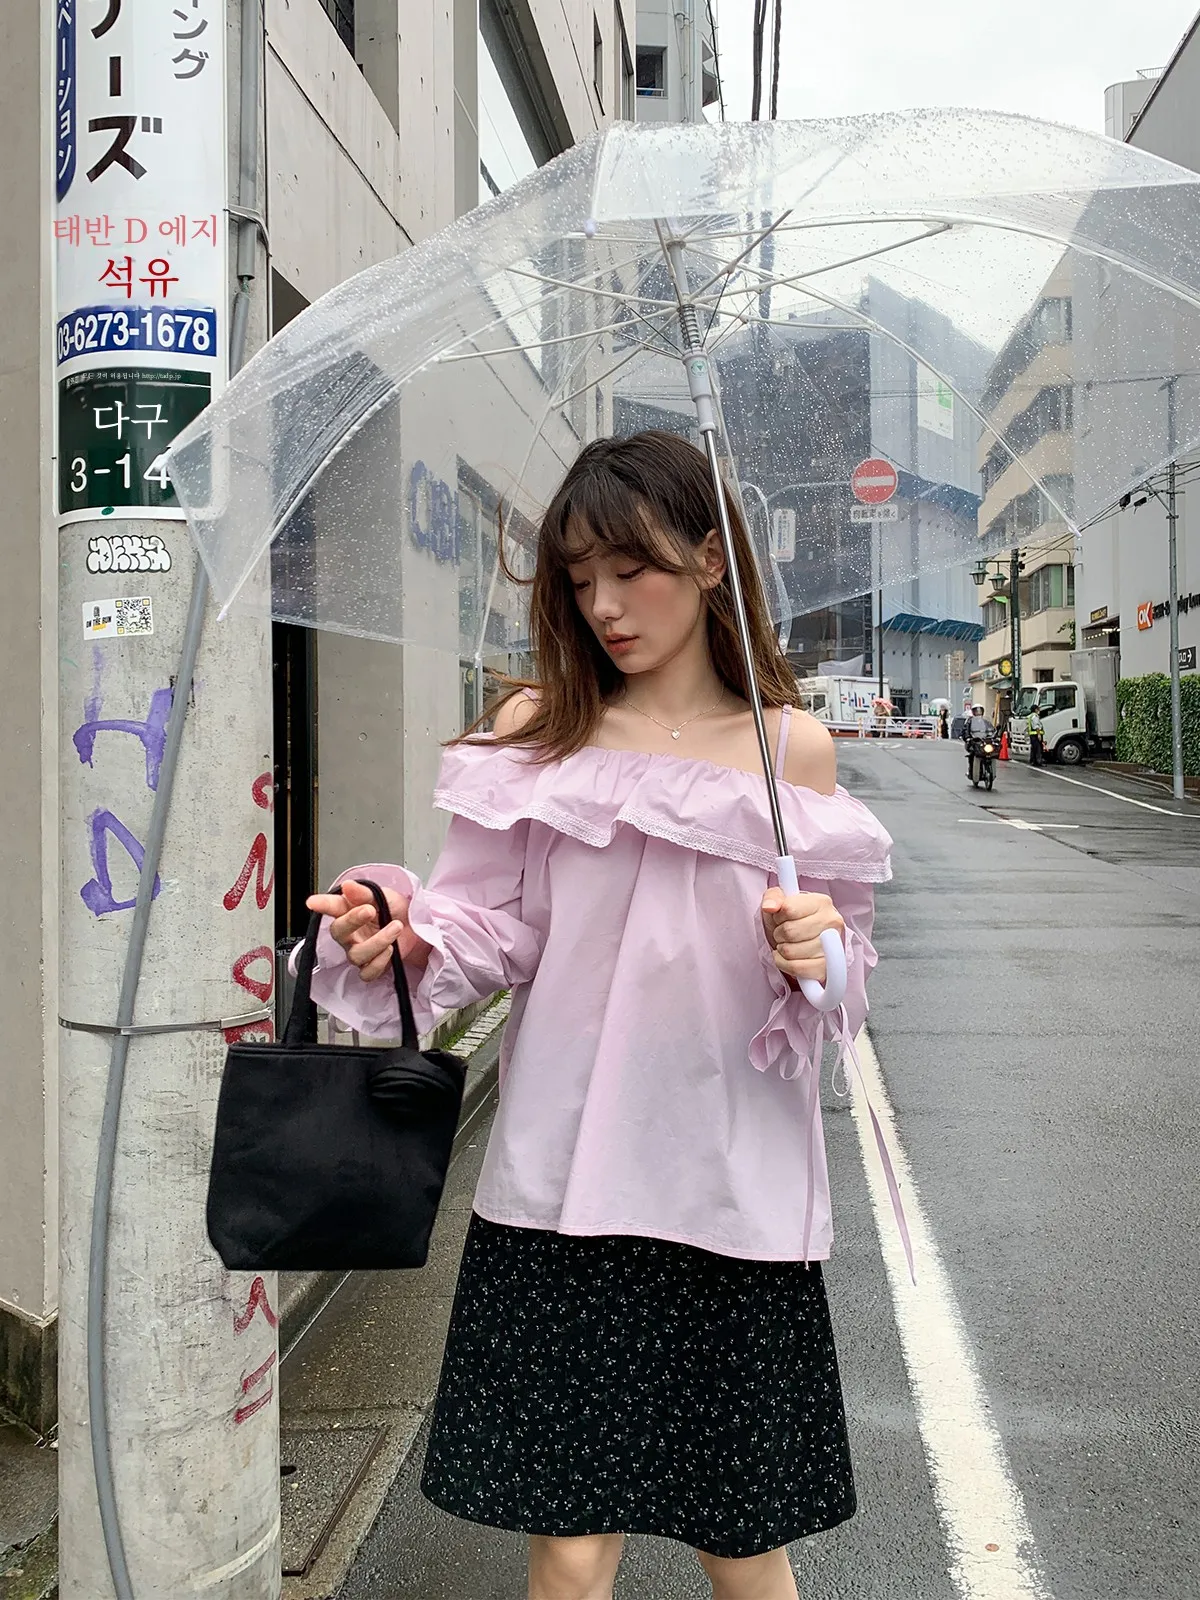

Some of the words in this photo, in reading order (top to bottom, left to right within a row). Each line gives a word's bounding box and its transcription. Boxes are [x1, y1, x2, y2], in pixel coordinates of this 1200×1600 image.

[53, 214, 116, 248] 태반
[124, 218, 148, 244] D
[158, 214, 218, 248] 에지
[98, 255, 180, 299] 석유
[57, 311, 211, 360] 03-6273-1678
[93, 400, 169, 440] 다구
[70, 453, 171, 492] 3-14
